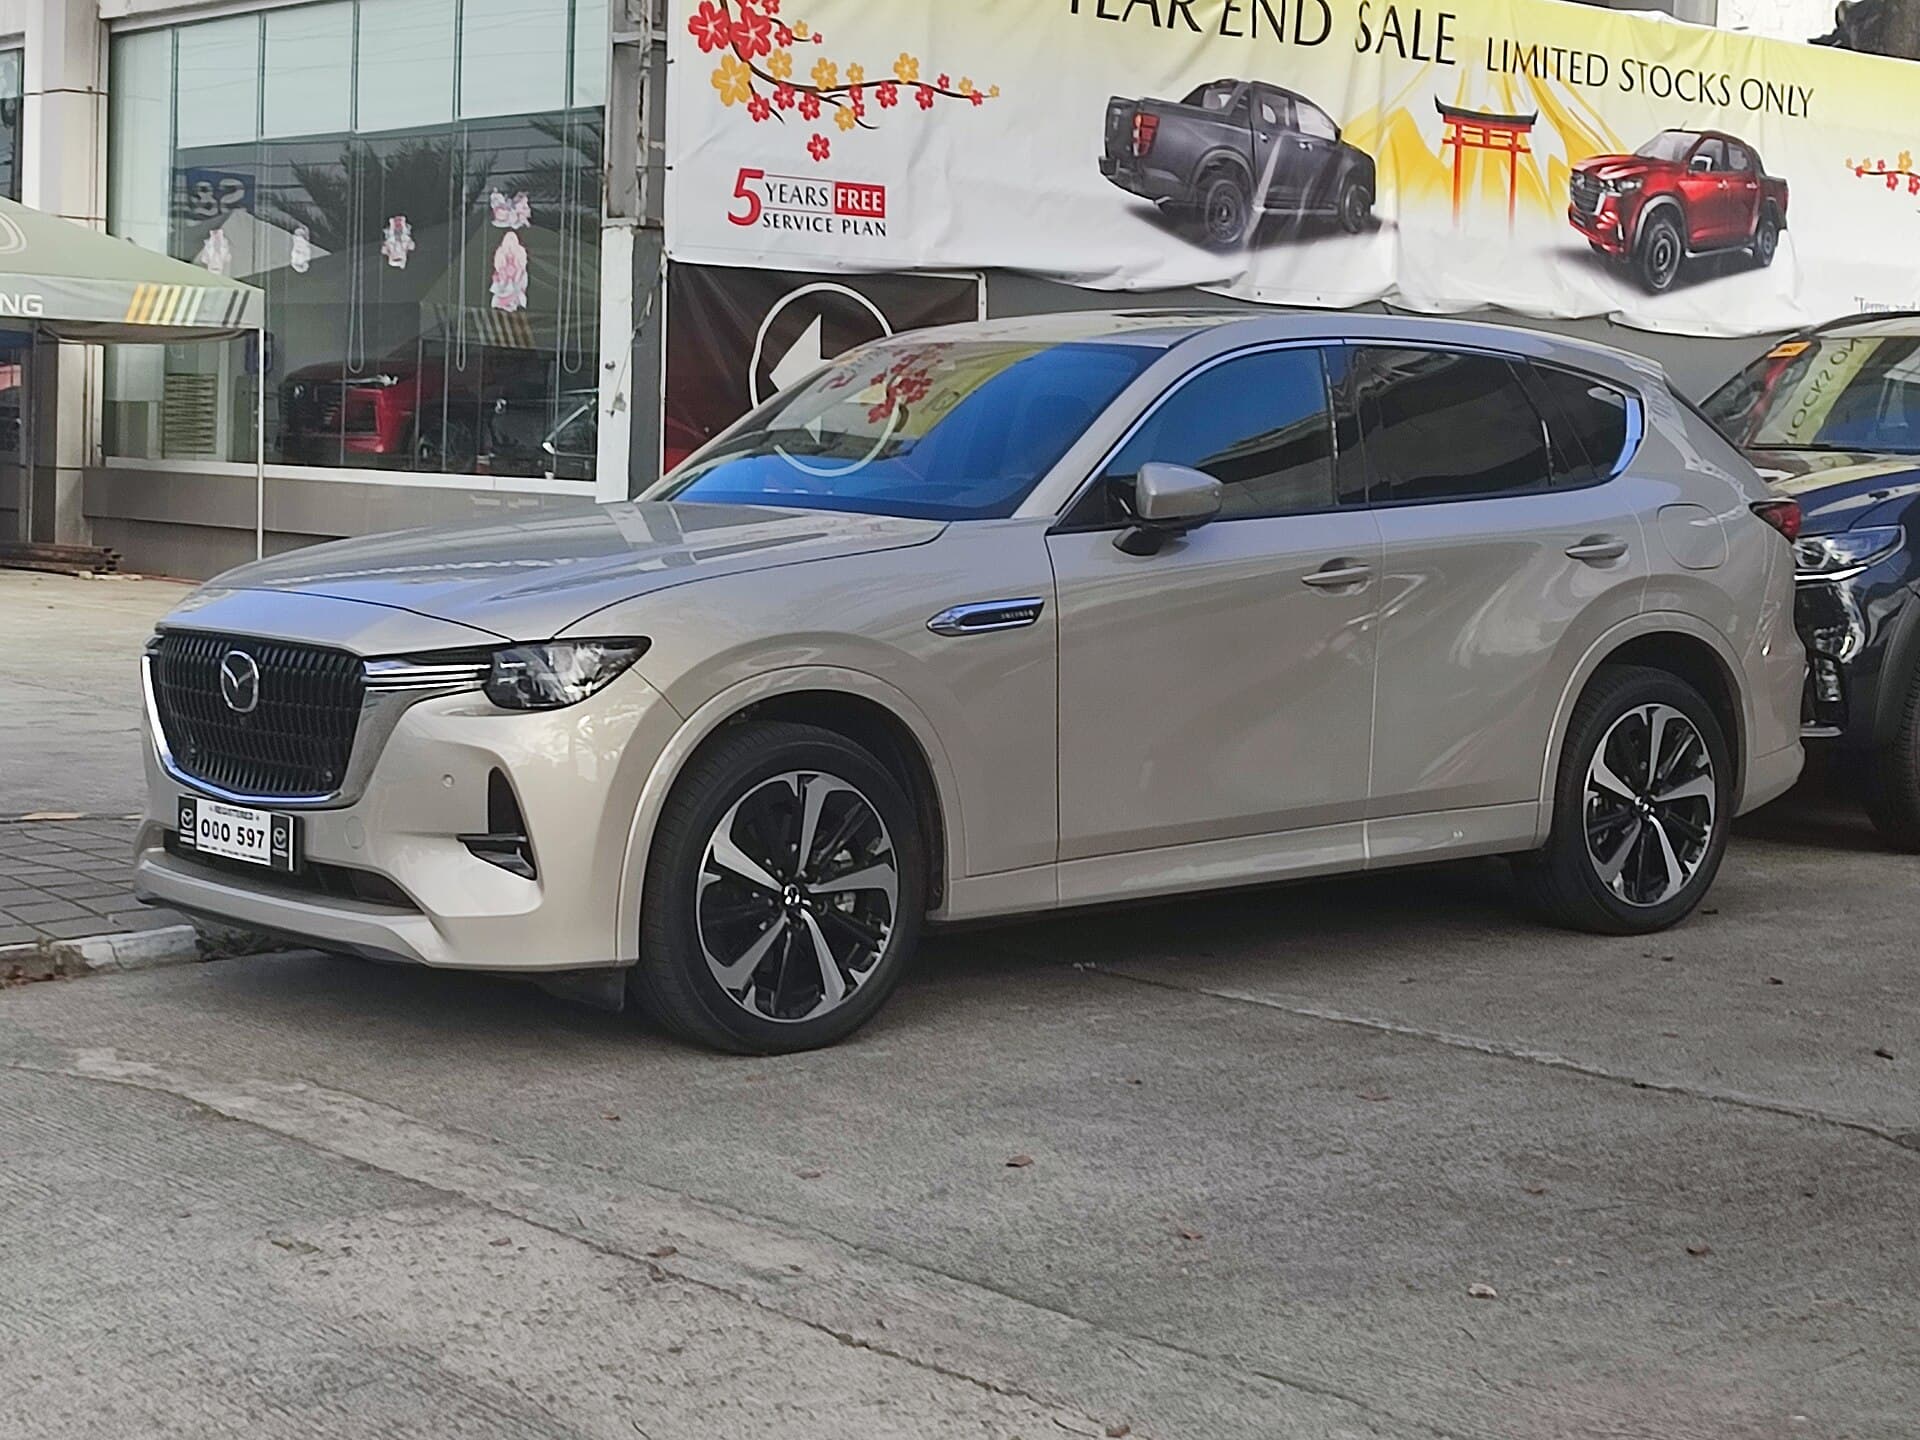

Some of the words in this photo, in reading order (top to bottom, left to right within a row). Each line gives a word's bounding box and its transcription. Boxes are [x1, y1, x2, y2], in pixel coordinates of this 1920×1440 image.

[1071, 0, 1202, 32] AR
[1219, 0, 1332, 46] END
[1355, 0, 1456, 65] SALE
[1486, 37, 1609, 87] LIMITED
[1619, 58, 1730, 106] STOCKS
[1740, 78, 1815, 118] ONLY
[728, 168, 765, 226] 5
[765, 182, 829, 207] YEARS
[836, 188, 883, 212] FREE
[762, 212, 833, 233] SERVICE
[842, 219, 887, 237] PLAN
[237, 826, 265, 849] 597
